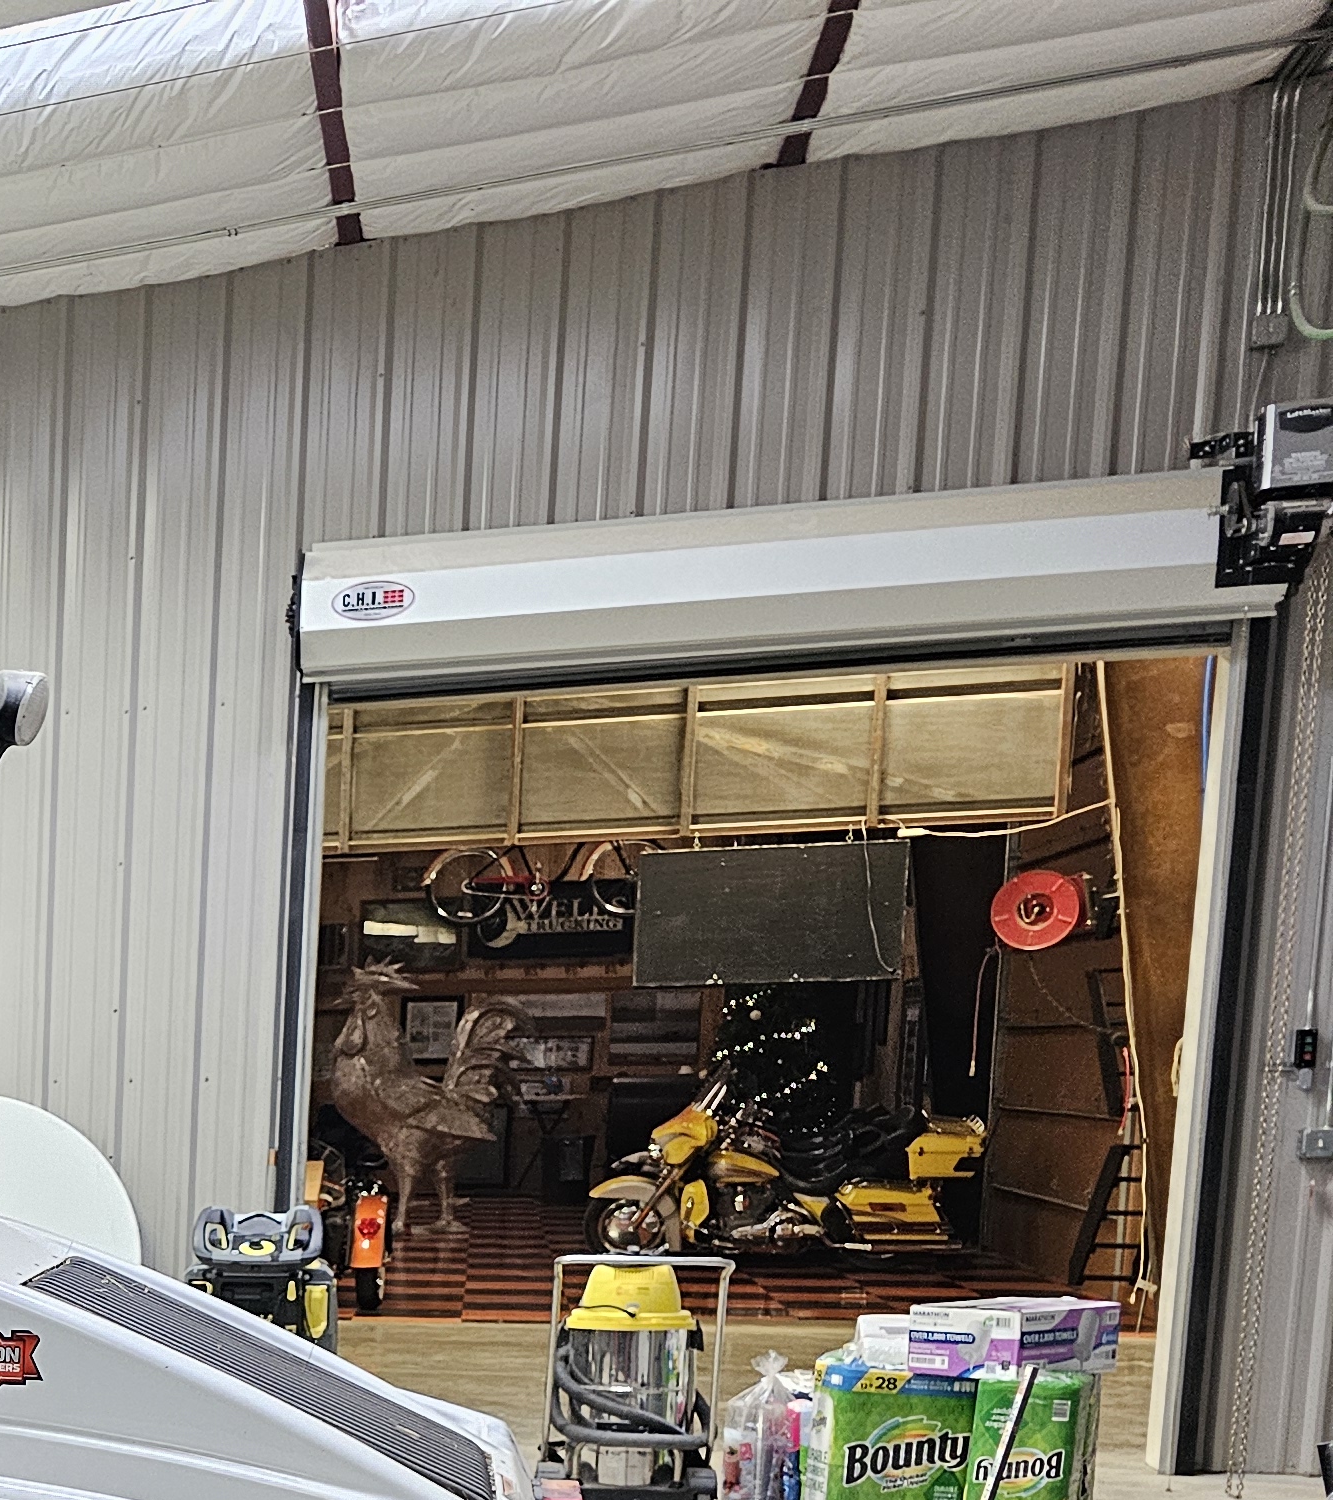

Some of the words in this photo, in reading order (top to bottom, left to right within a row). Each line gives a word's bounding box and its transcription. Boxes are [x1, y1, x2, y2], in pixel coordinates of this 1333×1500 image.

[342, 591, 381, 607] C.H.I.
[525, 919, 621, 932] TRUCKING
[874, 1376, 898, 1390] 28
[844, 1431, 972, 1486] Bounty
